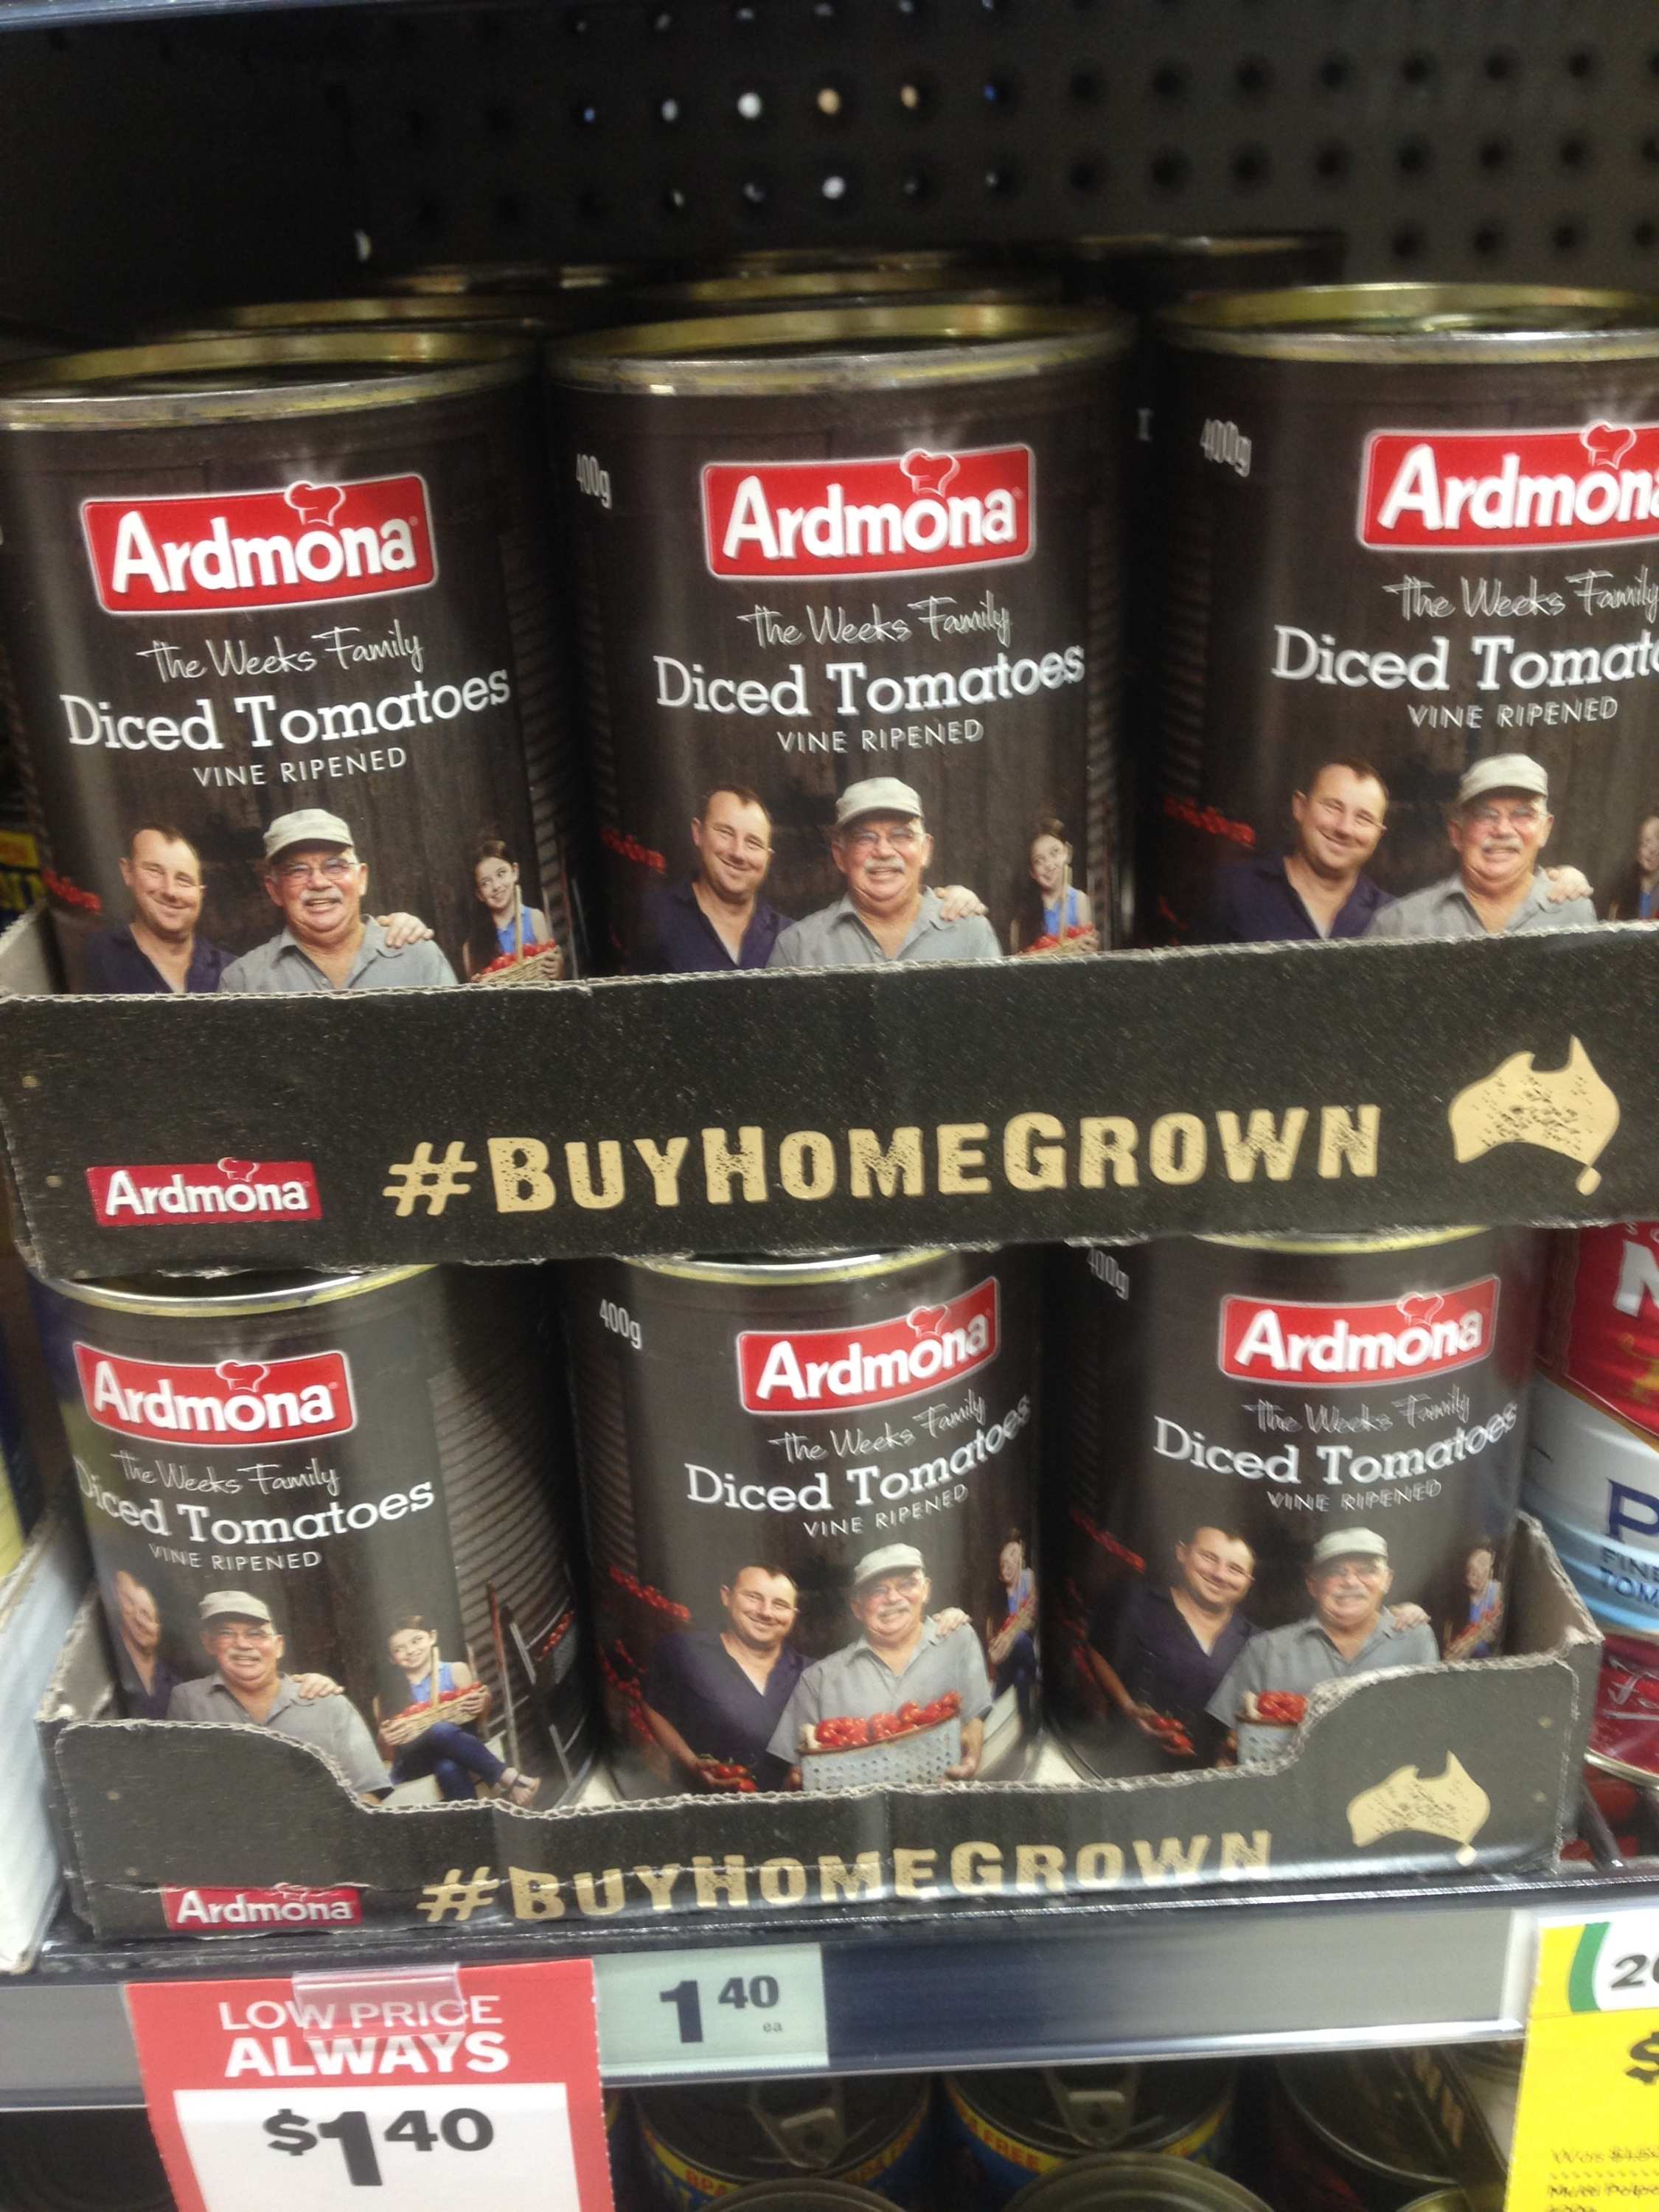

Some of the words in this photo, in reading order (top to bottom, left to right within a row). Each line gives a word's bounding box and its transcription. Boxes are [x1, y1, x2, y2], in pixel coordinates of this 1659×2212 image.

[723, 475, 1018, 560] Ardmona
[1377, 444, 1659, 530] Ardmon
[111, 510, 418, 595] Ardmona
[737, 605, 804, 647] The
[807, 605, 911, 644] Weeks
[908, 589, 1013, 646] Family
[1382, 574, 1456, 620] The
[1460, 576, 1566, 617] Weeks
[1565, 566, 1659, 624] Family
[136, 640, 206, 683] The
[206, 636, 319, 681] Weeks
[311, 619, 425, 672] Family
[653, 655, 810, 715] Diced
[827, 644, 1085, 715] Tomatoes
[1271, 625, 1450, 691] Diced
[59, 695, 223, 751] Diced
[235, 668, 512, 748] Tomatoes
[777, 730, 848, 754] VINE
[861, 718, 984, 751] RIPENED
[1408, 704, 1483, 729] VINE
[1497, 695, 1618, 727] RIPENED
[193, 764, 267, 787] VINE
[280, 747, 408, 783] RIPENED
[105, 1168, 311, 1217] Ardmona
[383, 1104, 1381, 1217] #BUYHOMEGROWN
[599, 1299, 642, 1350] 400g
[1234, 1308, 1483, 1373] Ardmona
[756, 1314, 988, 1400] Ardmona
[94, 1360, 335, 1433] Ardmona
[768, 1431, 828, 1464] The
[830, 1422, 917, 1459] Weeks
[912, 1388, 987, 1439] Family
[110, 1450, 158, 1484] The
[155, 1459, 242, 1495] Weeks
[237, 1457, 341, 1498] Family
[684, 1462, 833, 1512] Diced
[846, 1395, 1032, 1507] Tomatoes
[1153, 1415, 1301, 1485] Diced
[1316, 1401, 1519, 1485] Tomatoes
[176, 1481, 435, 1545] Tomatoes
[803, 1517, 863, 1538] VINE
[874, 1484, 969, 1529] RIPENED
[1267, 1490, 1331, 1512] VINE
[1340, 1479, 1442, 1510] RIPENED
[148, 1543, 201, 1568] VINE
[212, 1550, 323, 1572] RIPENED
[416, 1829, 1272, 1921] #BUYHOMEGROWN
[175, 1889, 354, 1926] Ardmona
[219, 1998, 335, 2032] LOW
[349, 1994, 504, 2028] PRICE
[225, 2031, 509, 2079] ALWAYS
